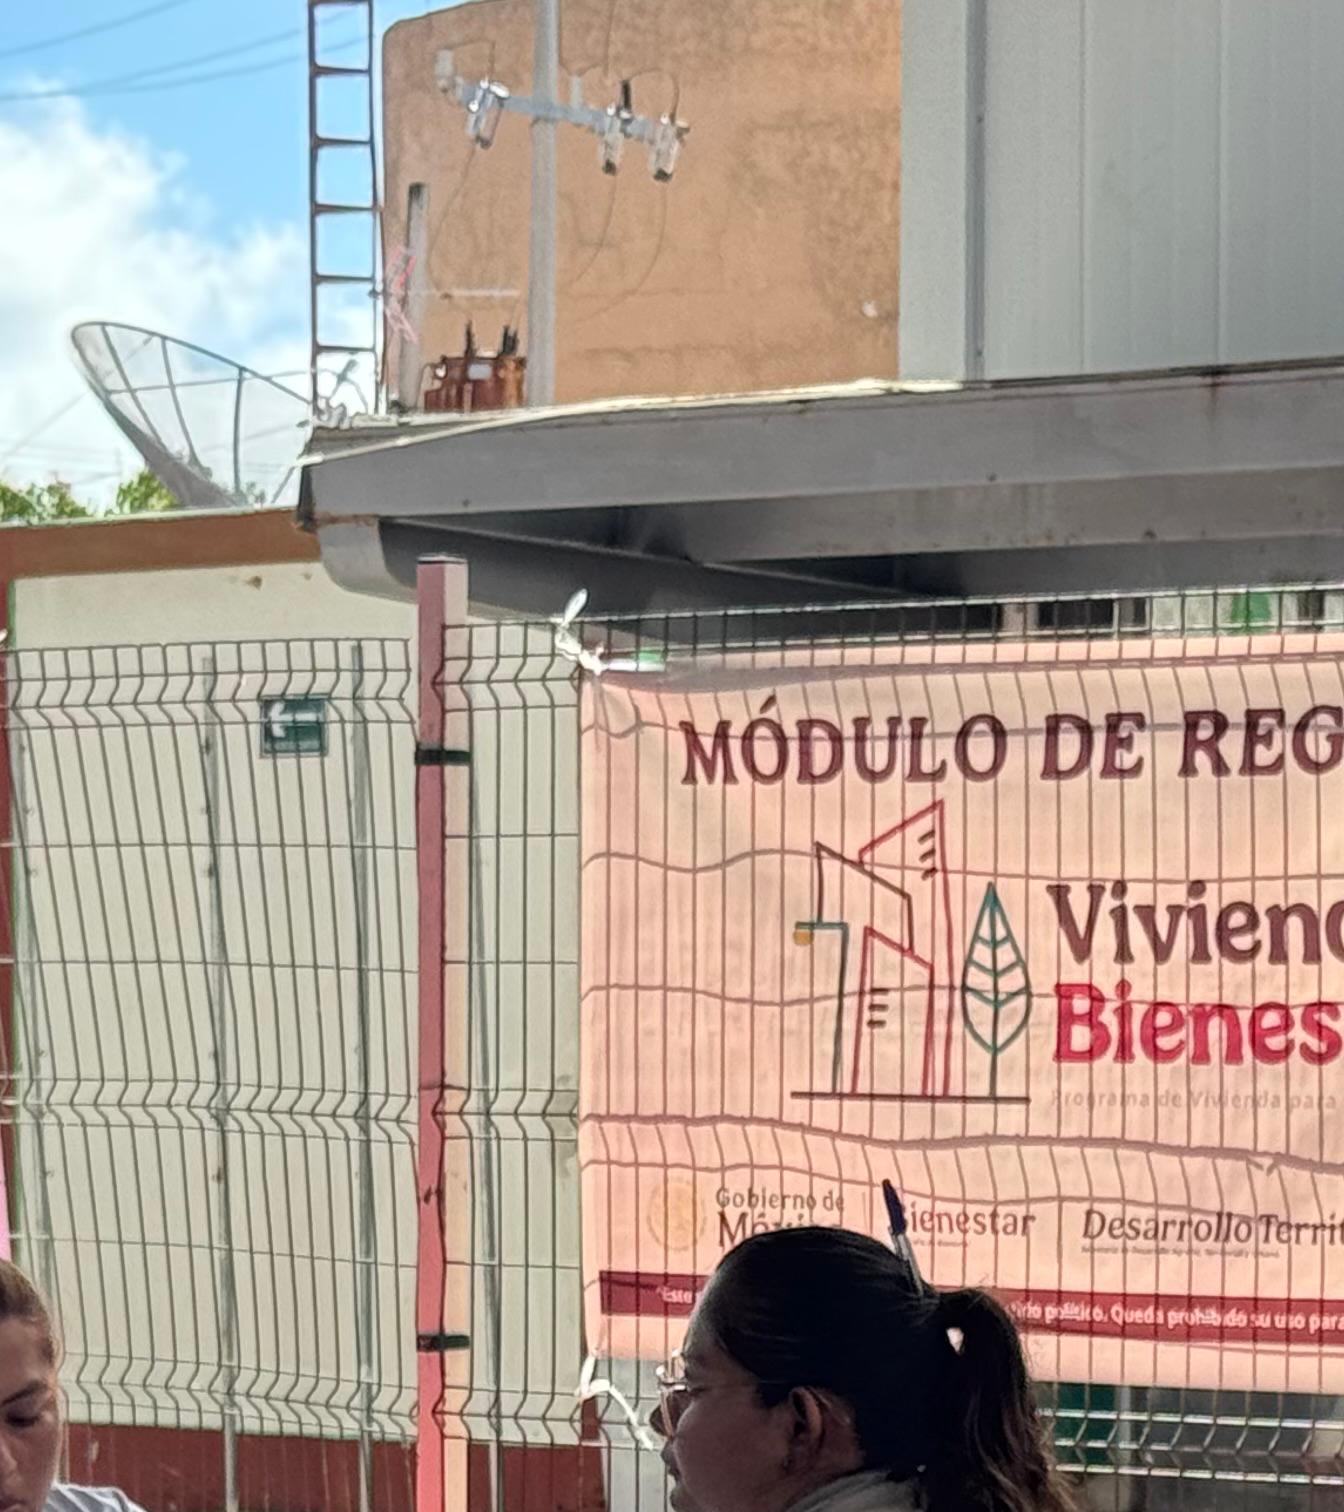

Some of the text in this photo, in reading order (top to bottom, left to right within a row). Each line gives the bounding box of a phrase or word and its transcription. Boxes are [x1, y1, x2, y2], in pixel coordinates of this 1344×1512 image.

[679, 695, 1009, 786] MÓDULO
[1038, 711, 1145, 781] DE
[715, 1186, 845, 1212] Gobierno de
[904, 1200, 1037, 1237] ienestar
[1082, 1209, 1253, 1245] Desarrollo
[1110, 1302, 1164, 1326] Queda
